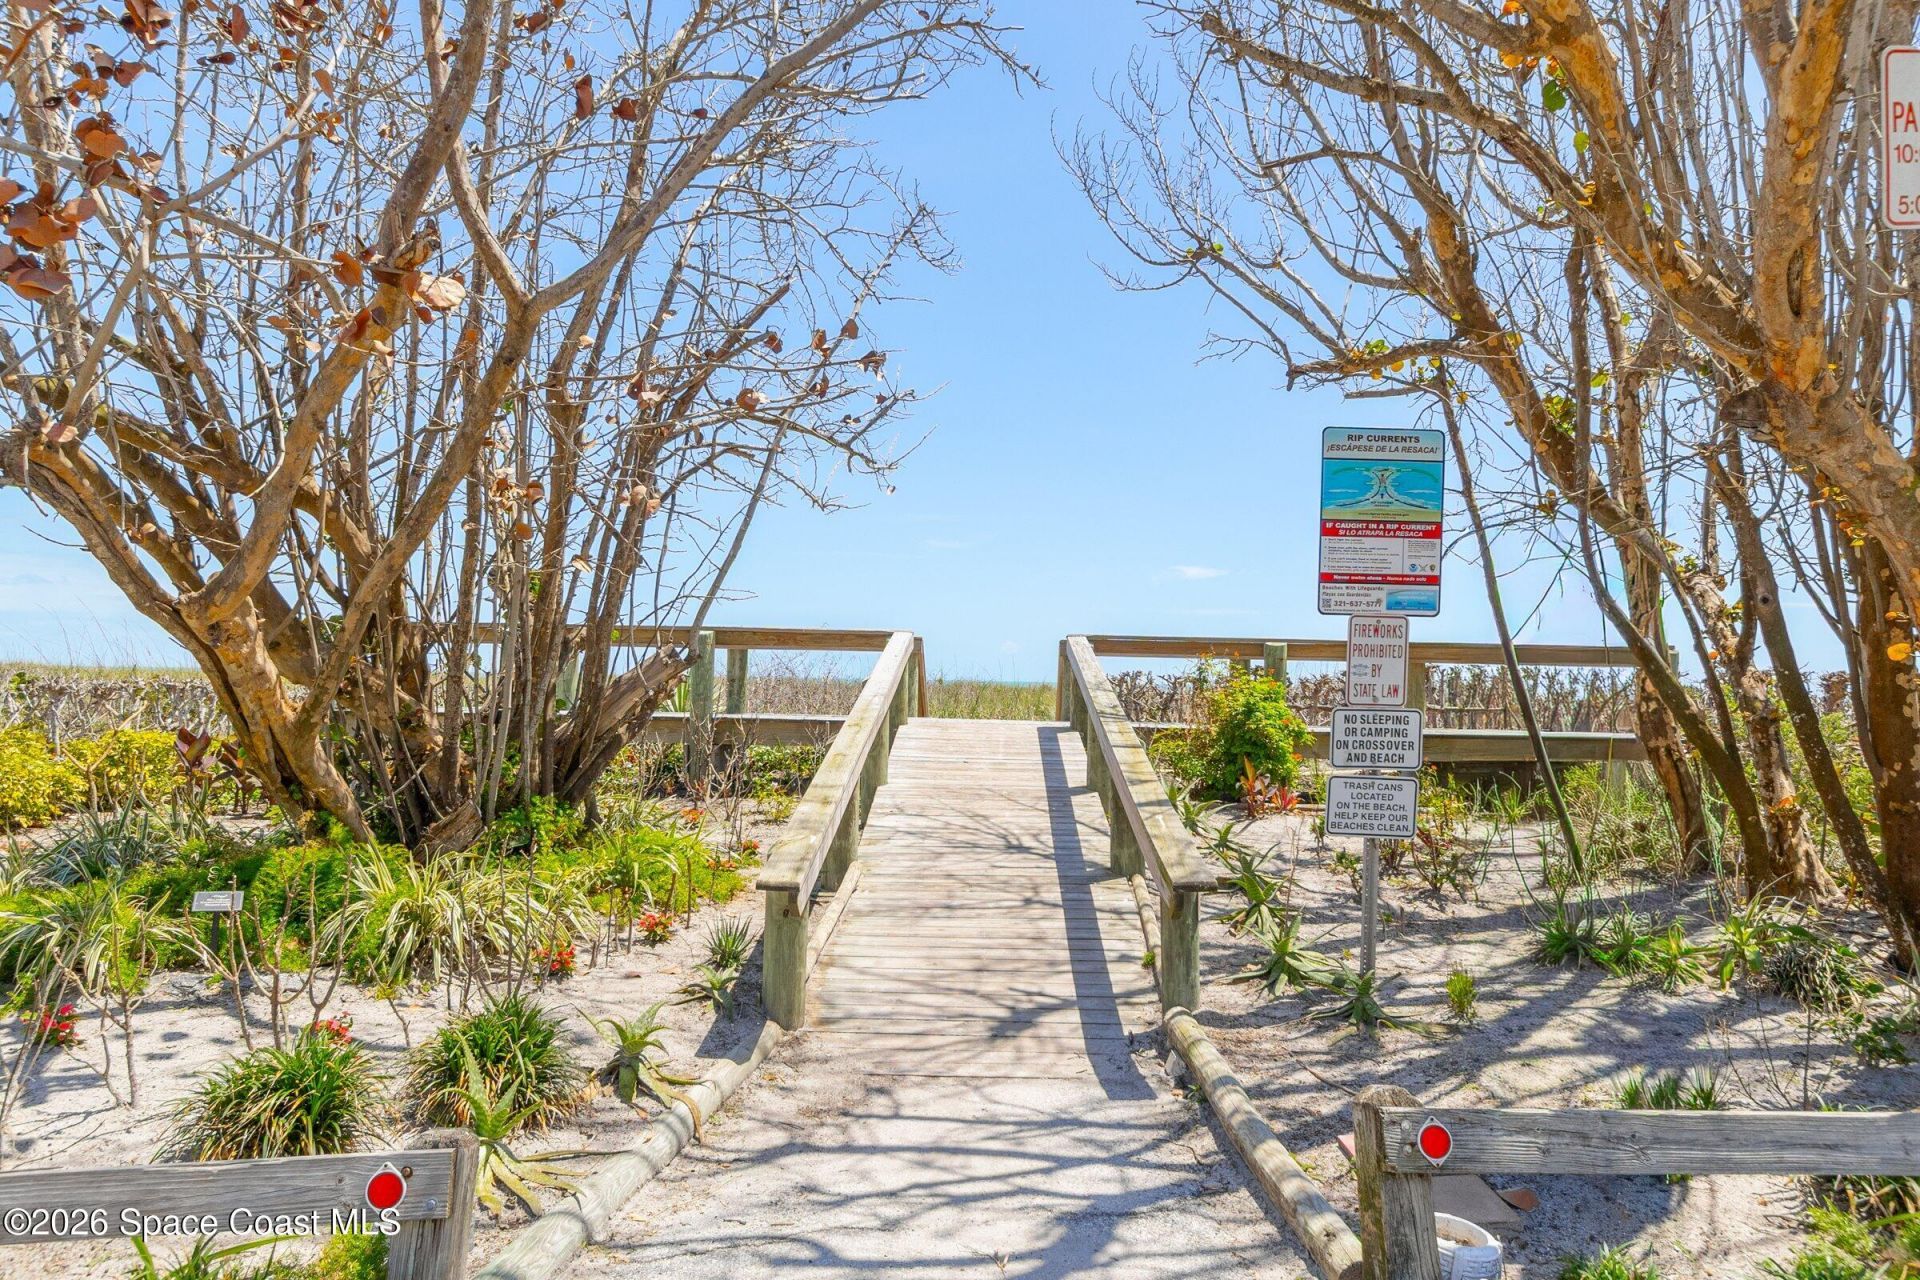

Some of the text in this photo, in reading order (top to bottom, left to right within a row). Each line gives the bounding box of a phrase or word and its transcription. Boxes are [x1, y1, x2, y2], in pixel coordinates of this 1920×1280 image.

[1893, 102, 1920, 132] PA
[1894, 144, 1920, 163] 10:
[1366, 435, 1420, 443] CURRENTS
[1354, 624, 1403, 639] FIREWORKS
[1352, 644, 1403, 658] PROHIBITED
[1372, 664, 1382, 677] BY
[1354, 683, 1399, 698] STATE LAW
[1344, 715, 1409, 725] NO SLEEPING
[1345, 727, 1408, 738] OR CAMPING
[1336, 740, 1414, 750] ON CROSSOVER
[1346, 753, 1404, 763] AND BEACH
[1344, 782, 1403, 791] TRASH CANS
[1351, 793, 1393, 801] LOCATED
[1352, 802, 1370, 810] THE
[1373, 803, 1407, 811] BEACH.
[1361, 812, 1385, 820] KEEP
[1388, 813, 1408, 821] OUR
[1331, 822, 1411, 832] BEACHES CLEAN.
